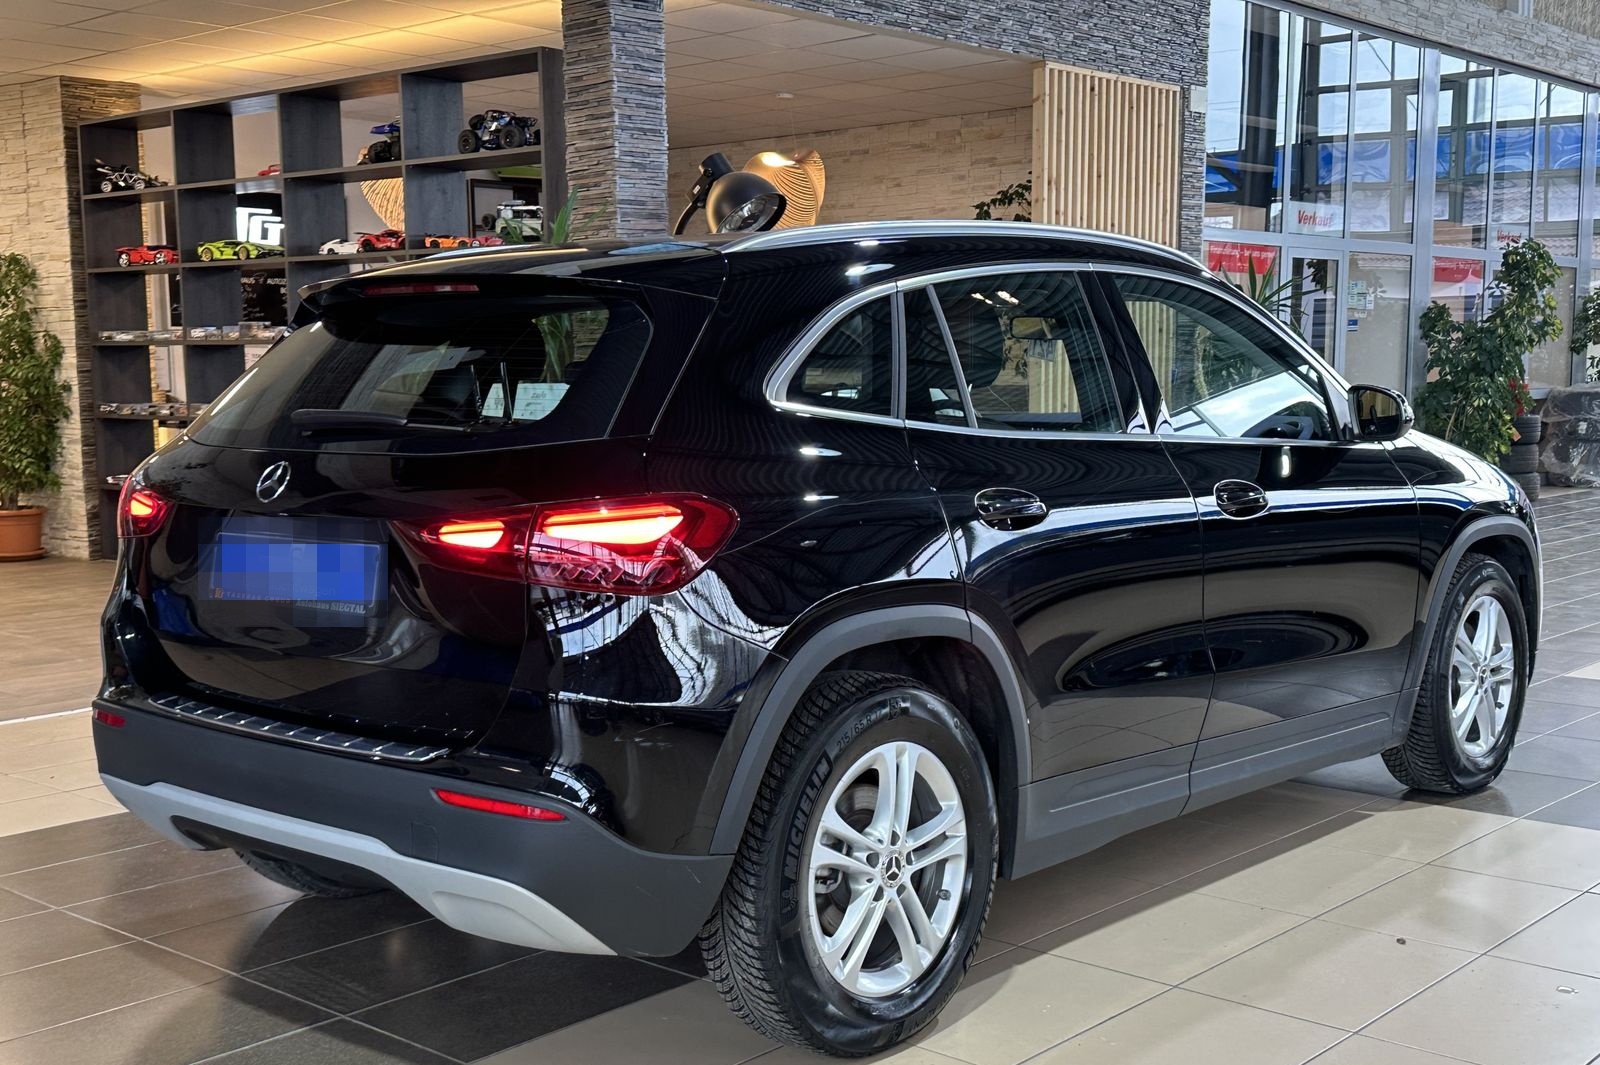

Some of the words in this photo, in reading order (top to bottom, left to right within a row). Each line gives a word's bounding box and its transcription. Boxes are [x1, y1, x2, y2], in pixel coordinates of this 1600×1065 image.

[330, 602, 366, 614] SIEGTAL
[836, 719, 865, 753] 215/65
[784, 755, 831, 880] MICHELIN
